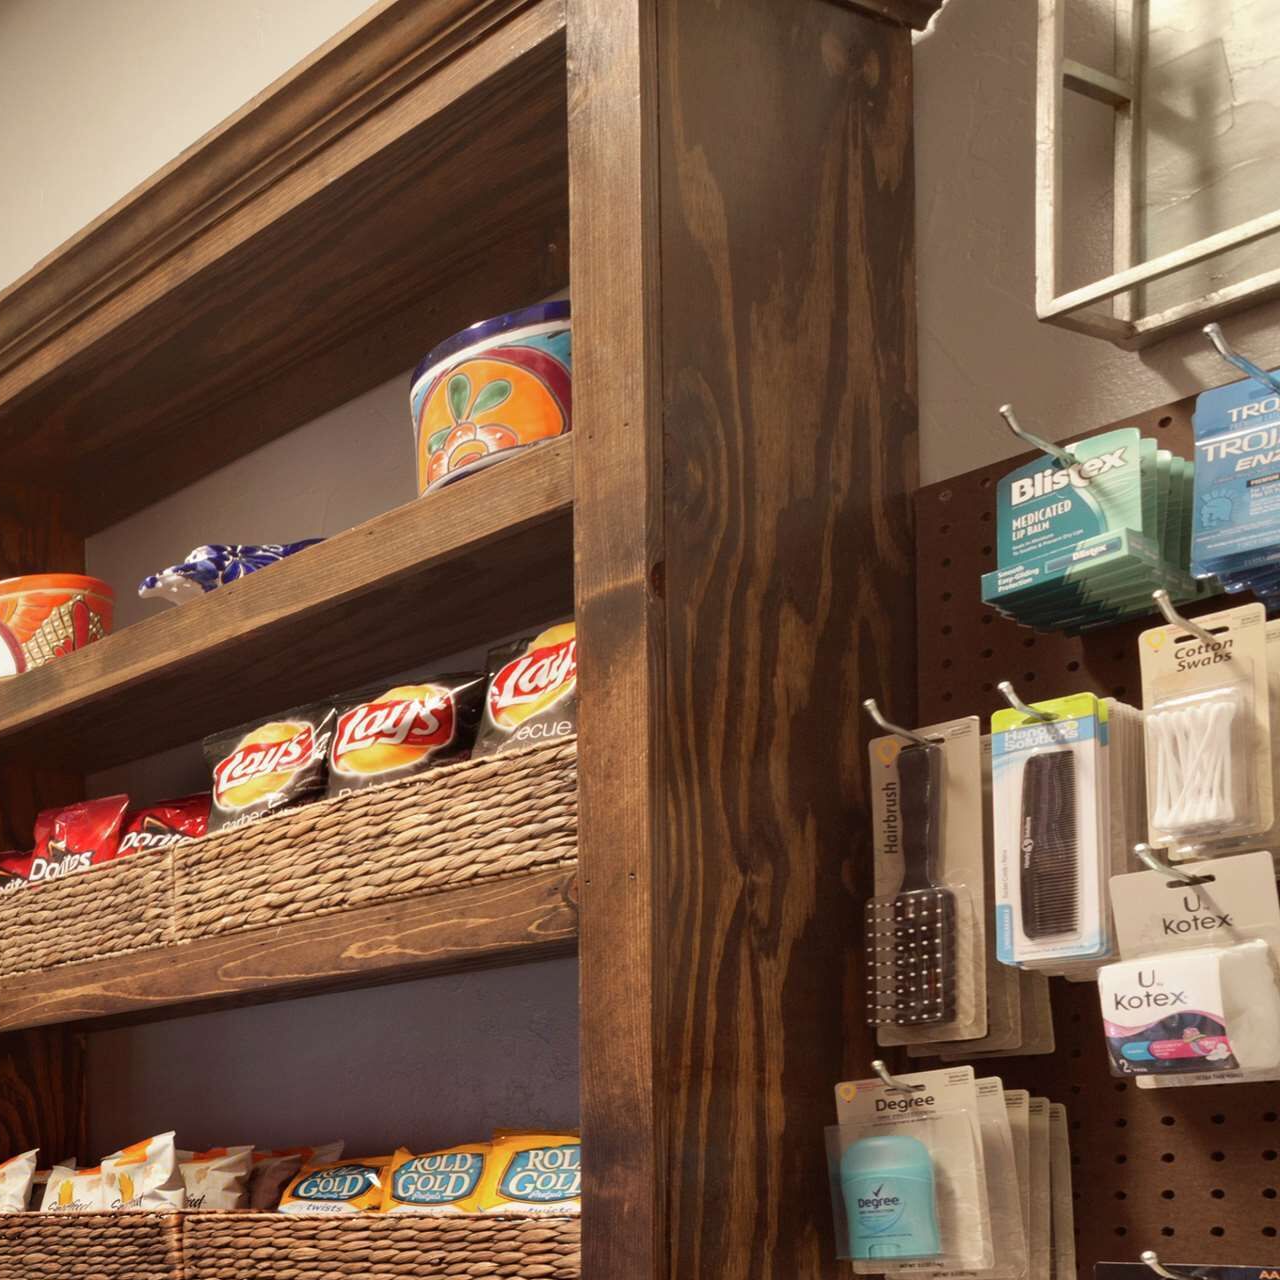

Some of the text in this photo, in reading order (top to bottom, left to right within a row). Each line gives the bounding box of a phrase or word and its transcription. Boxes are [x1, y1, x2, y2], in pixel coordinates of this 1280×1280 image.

[1010, 446, 1128, 507] Blistex
[1012, 499, 1072, 531] MEDICATED
[1012, 520, 1051, 541] LIP BALM
[1174, 637, 1234, 661] Cotton
[1176, 651, 1233, 673] Swabs
[336, 694, 440, 754] Lay's
[220, 734, 312, 792] Lay's
[883, 781, 899, 856] Hairbrush
[29, 852, 92, 881] Doritos
[1184, 894, 1202, 914] U
[1162, 912, 1234, 936] kotex
[1138, 969, 1157, 989] U
[1114, 989, 1187, 1012] kotex
[1118, 1058, 1131, 1073] 2
[875, 1095, 936, 1113] Degree
[409, 1153, 473, 1174] ROLD
[297, 1173, 367, 1197] GOLD
[396, 1171, 474, 1198] GOLD
[305, 1202, 344, 1213] twists
[857, 1196, 901, 1210] Degree
